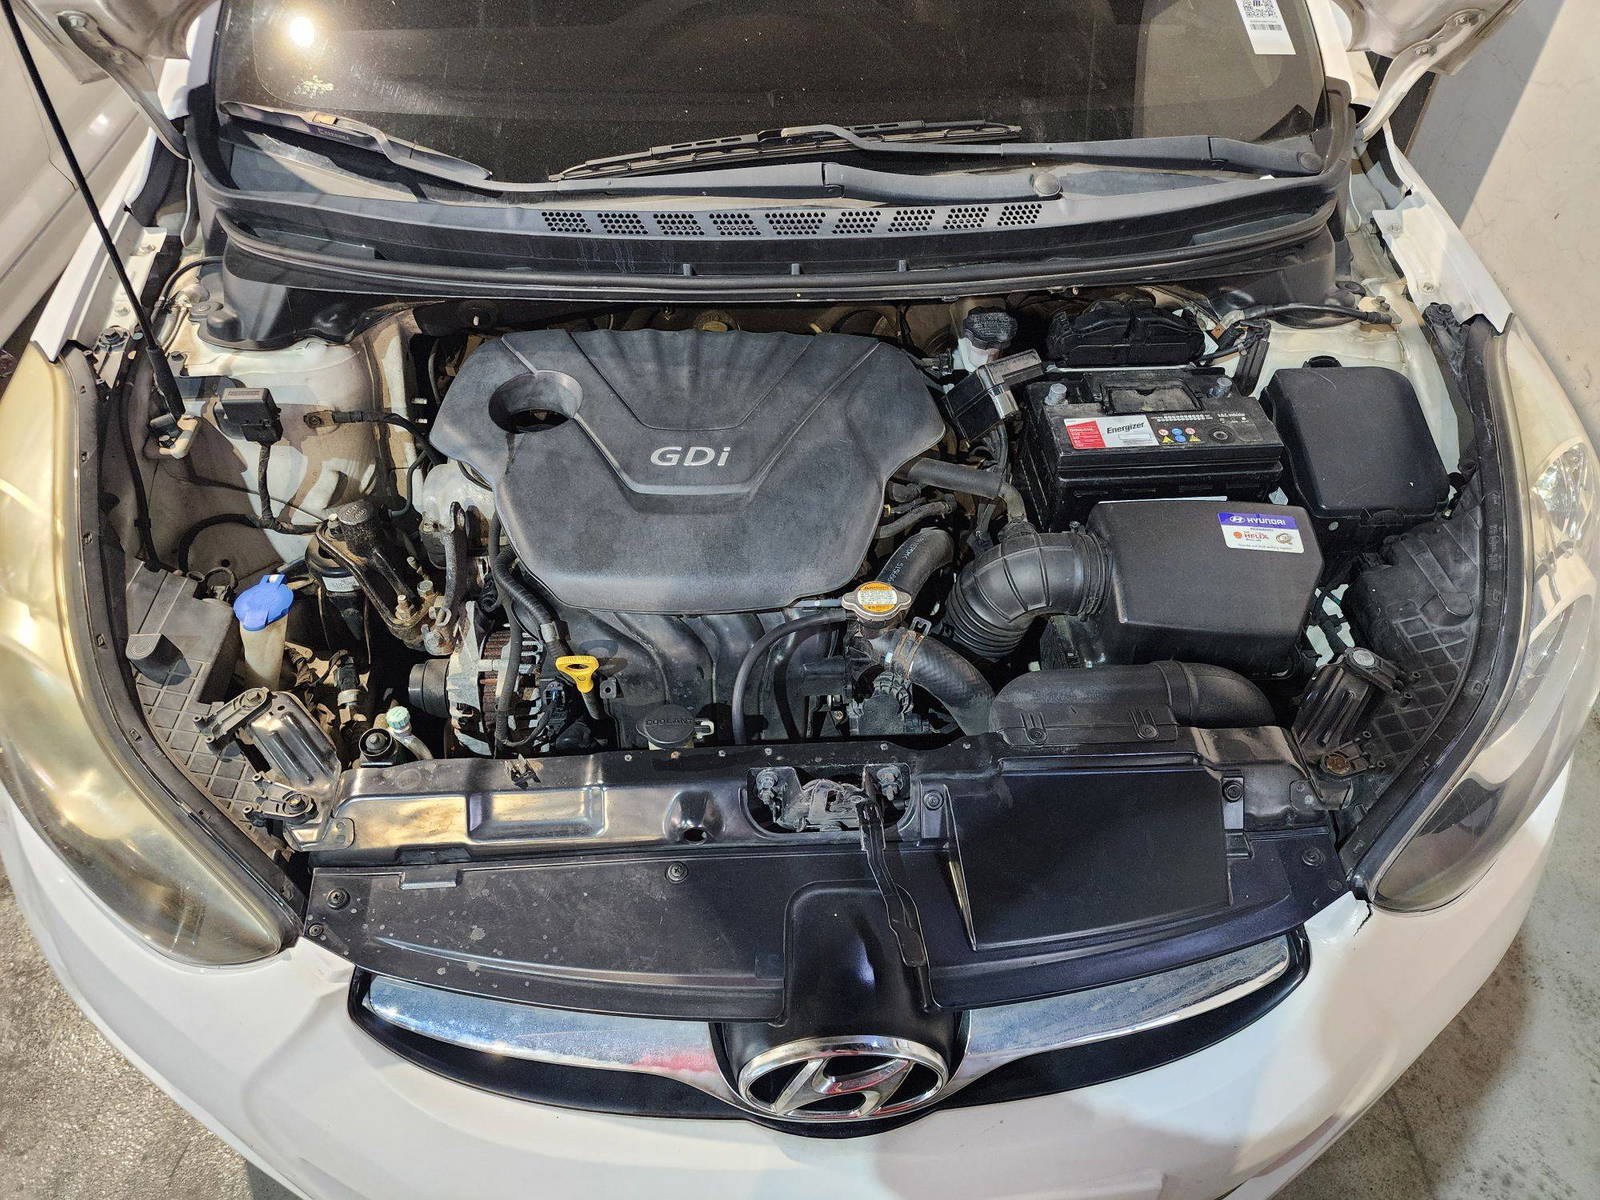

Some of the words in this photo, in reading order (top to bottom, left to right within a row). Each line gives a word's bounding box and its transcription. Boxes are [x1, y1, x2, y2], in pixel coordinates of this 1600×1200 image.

[1106, 421, 1145, 434] Energizer
[650, 446, 731, 466] GDi
[1247, 517, 1286, 526] HYUNDAI
